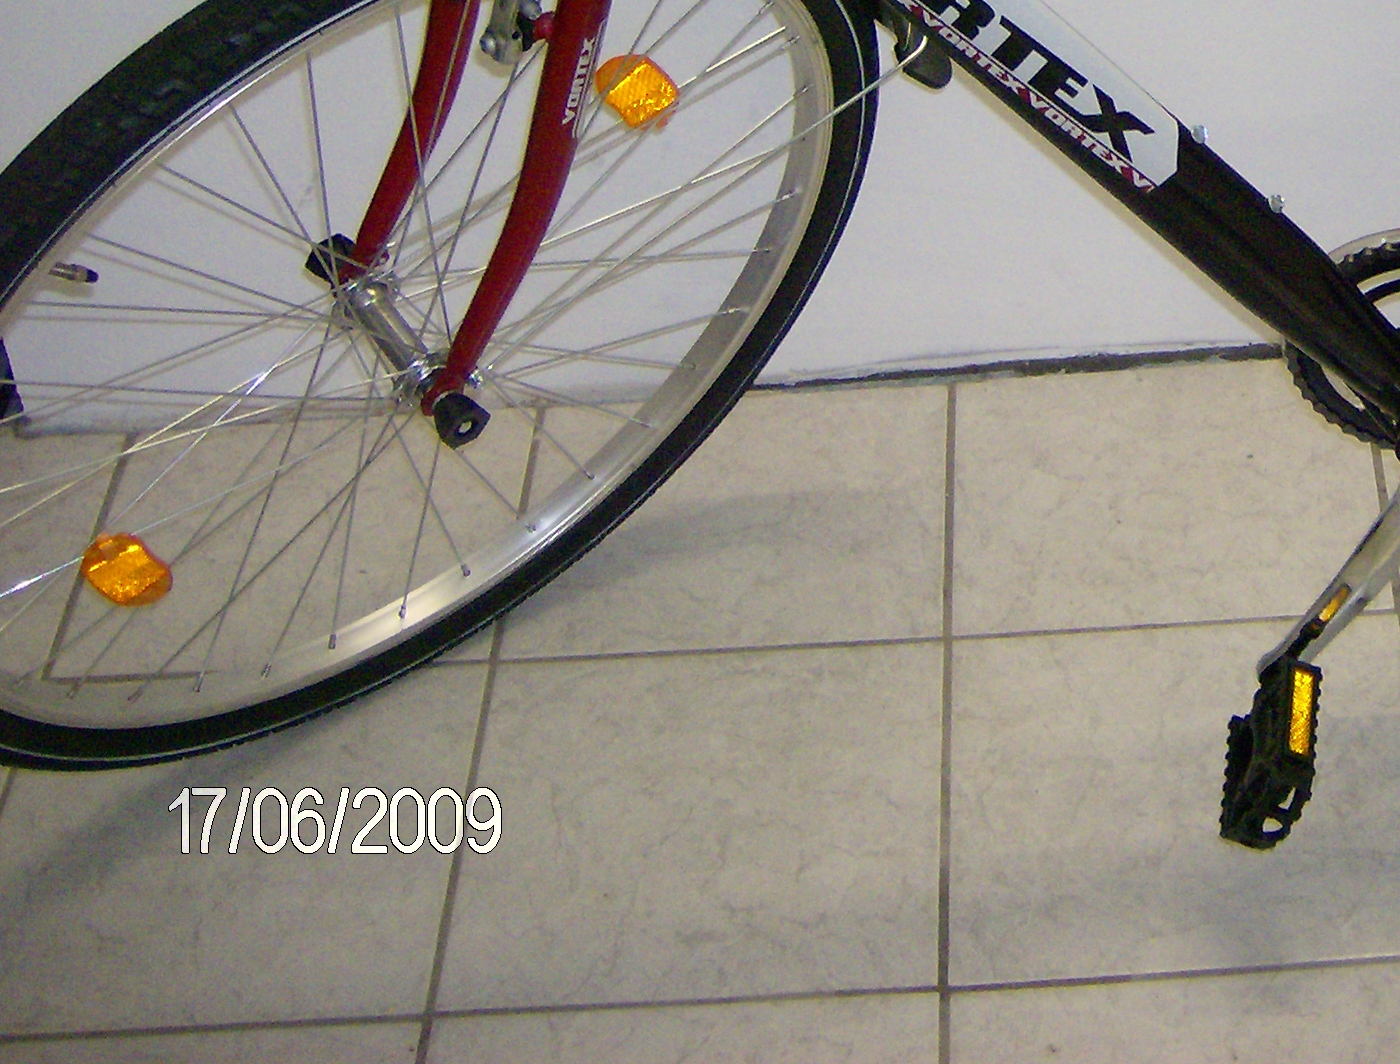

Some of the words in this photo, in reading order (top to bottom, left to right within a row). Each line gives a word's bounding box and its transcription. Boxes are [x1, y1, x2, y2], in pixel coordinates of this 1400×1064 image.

[562, 38, 596, 125] VORTEX
[922, 10, 1026, 94] VORTEX
[1029, 93, 1132, 175] VORTEX
